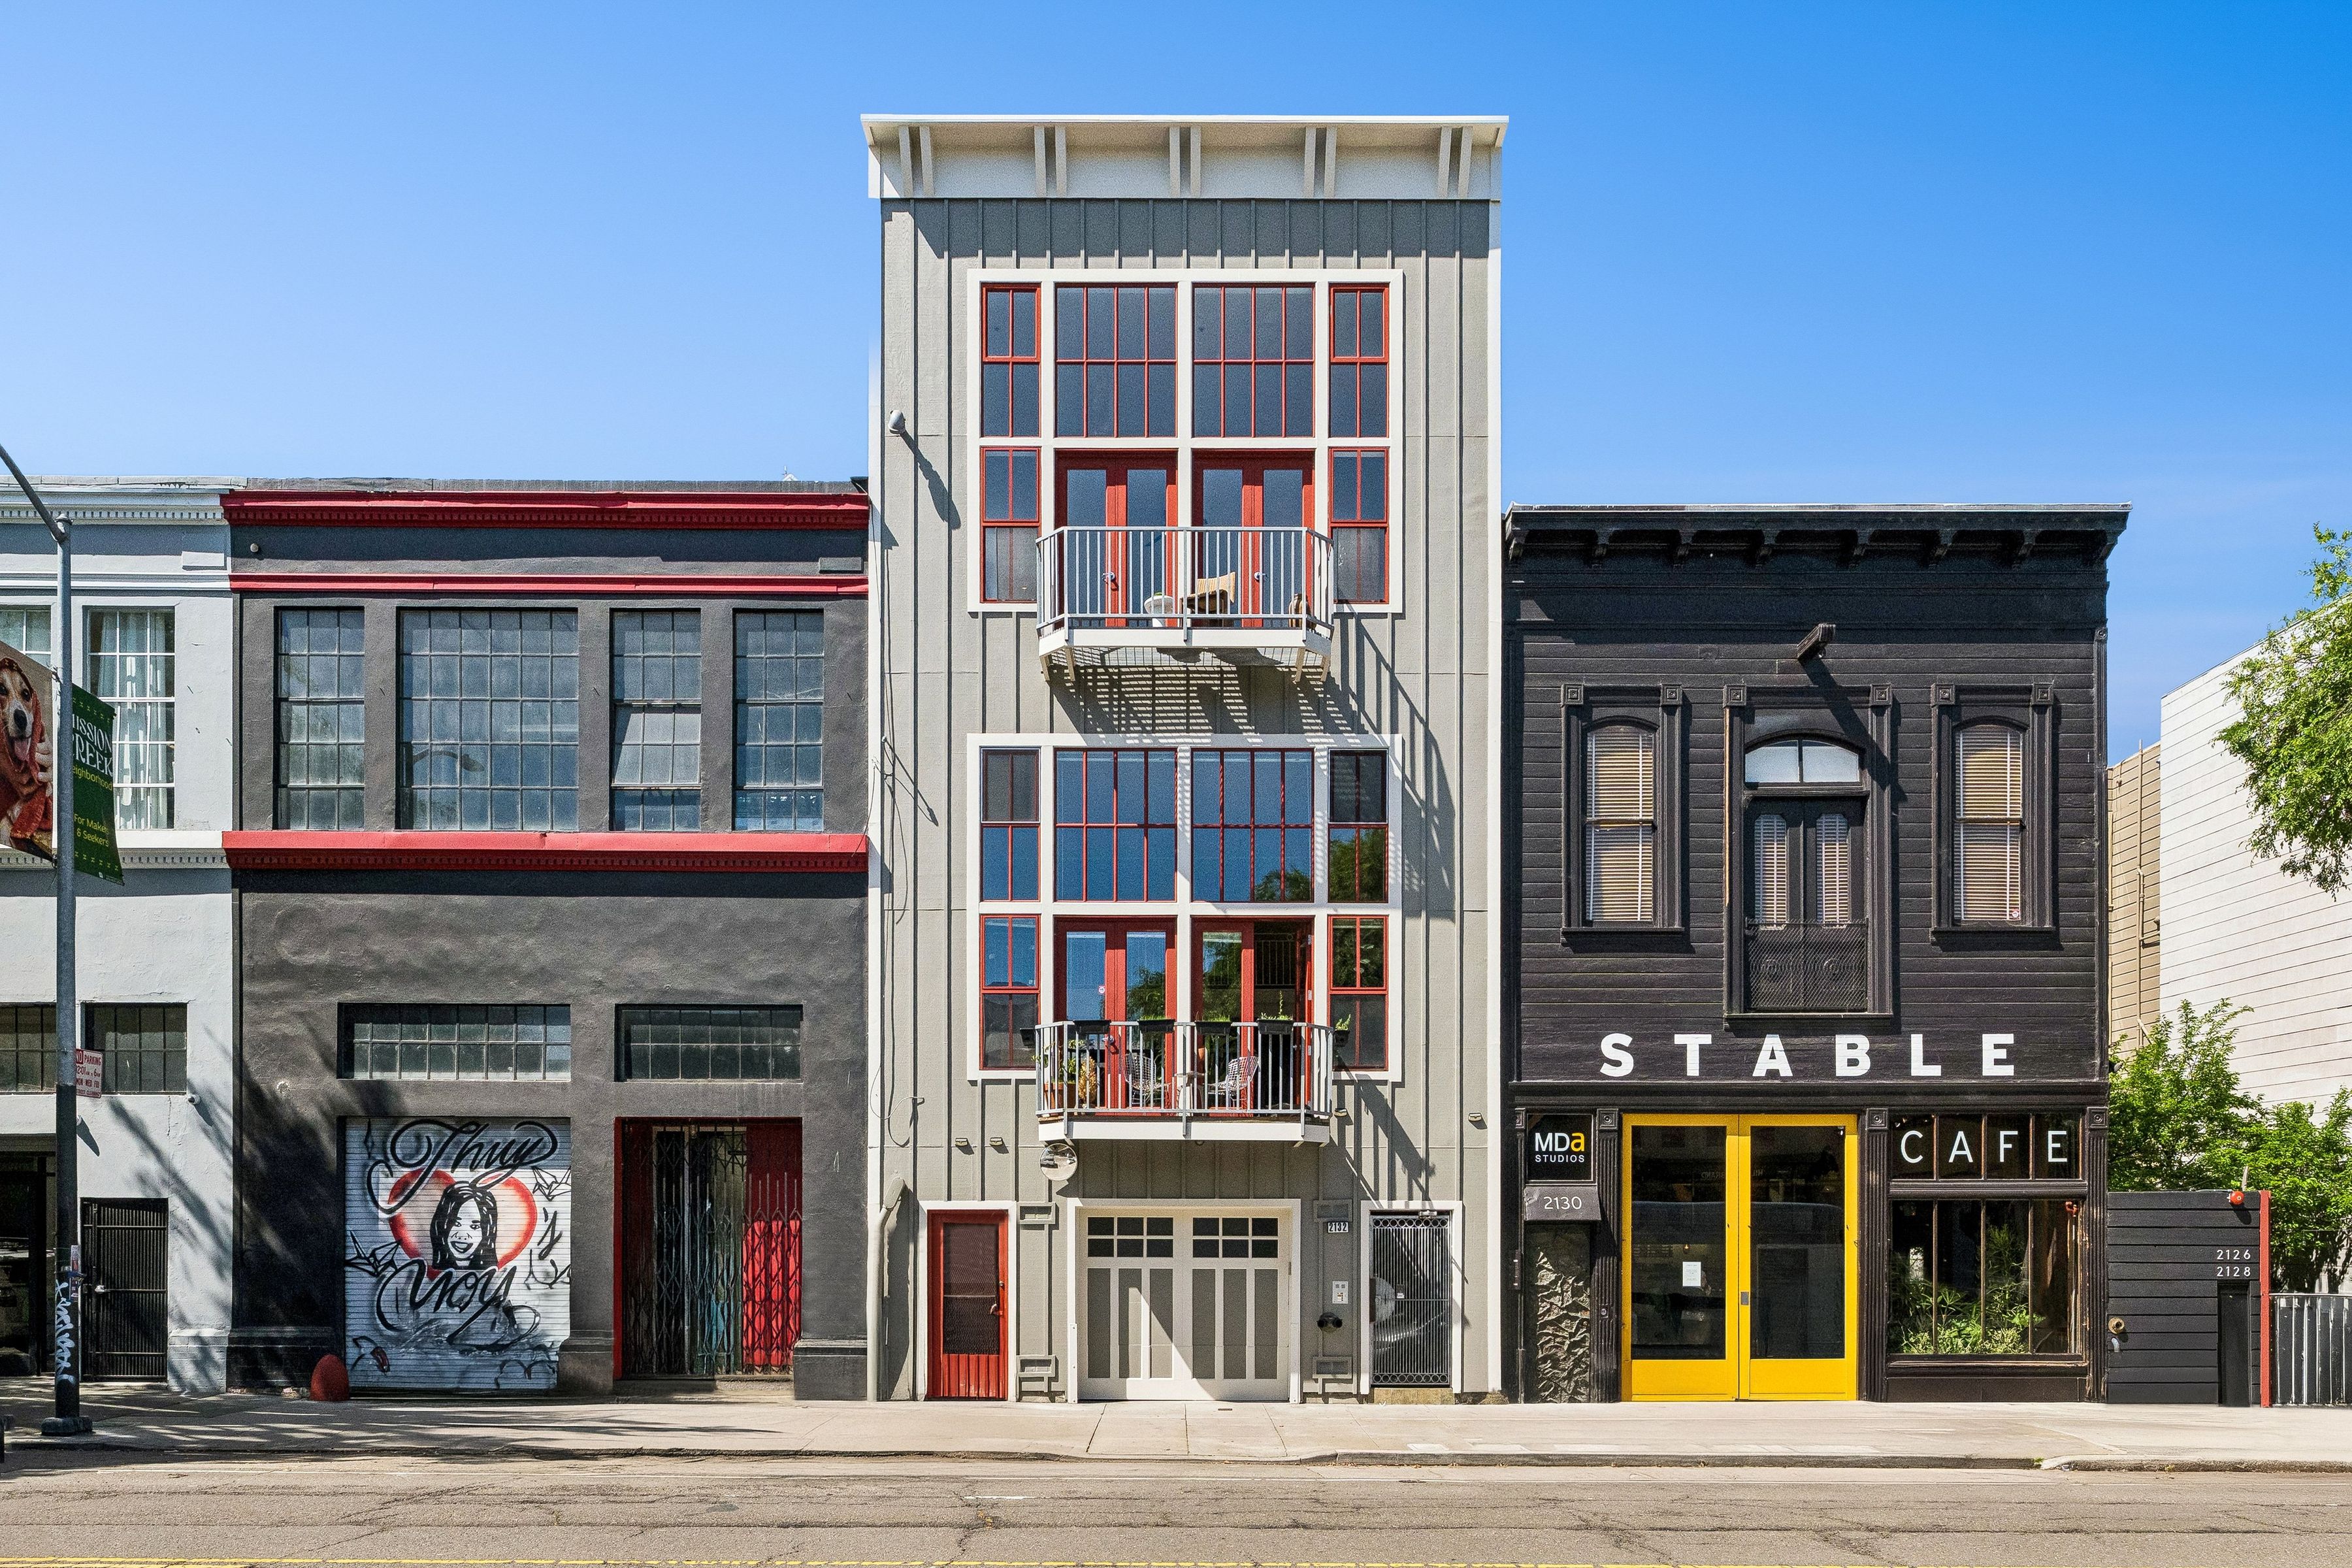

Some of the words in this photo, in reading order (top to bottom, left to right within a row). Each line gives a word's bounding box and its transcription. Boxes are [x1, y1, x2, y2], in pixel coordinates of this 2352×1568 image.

[72, 733, 112, 777] REEK
[72, 764, 112, 790] eighborhood
[74, 813, 86, 825] For
[83, 830, 109, 847] Seekers
[1601, 1034, 2014, 1077] STABLE
[1535, 1132, 1585, 1152] MDa
[1901, 1130, 2068, 1164] CAFE
[1535, 1154, 1585, 1163] STUDIOS
[1544, 1196, 1582, 1210] 2130
[1329, 1222, 1347, 1232] 2132
[2217, 1249, 2251, 1260] 2126
[2217, 1266, 2251, 1277] 2128
